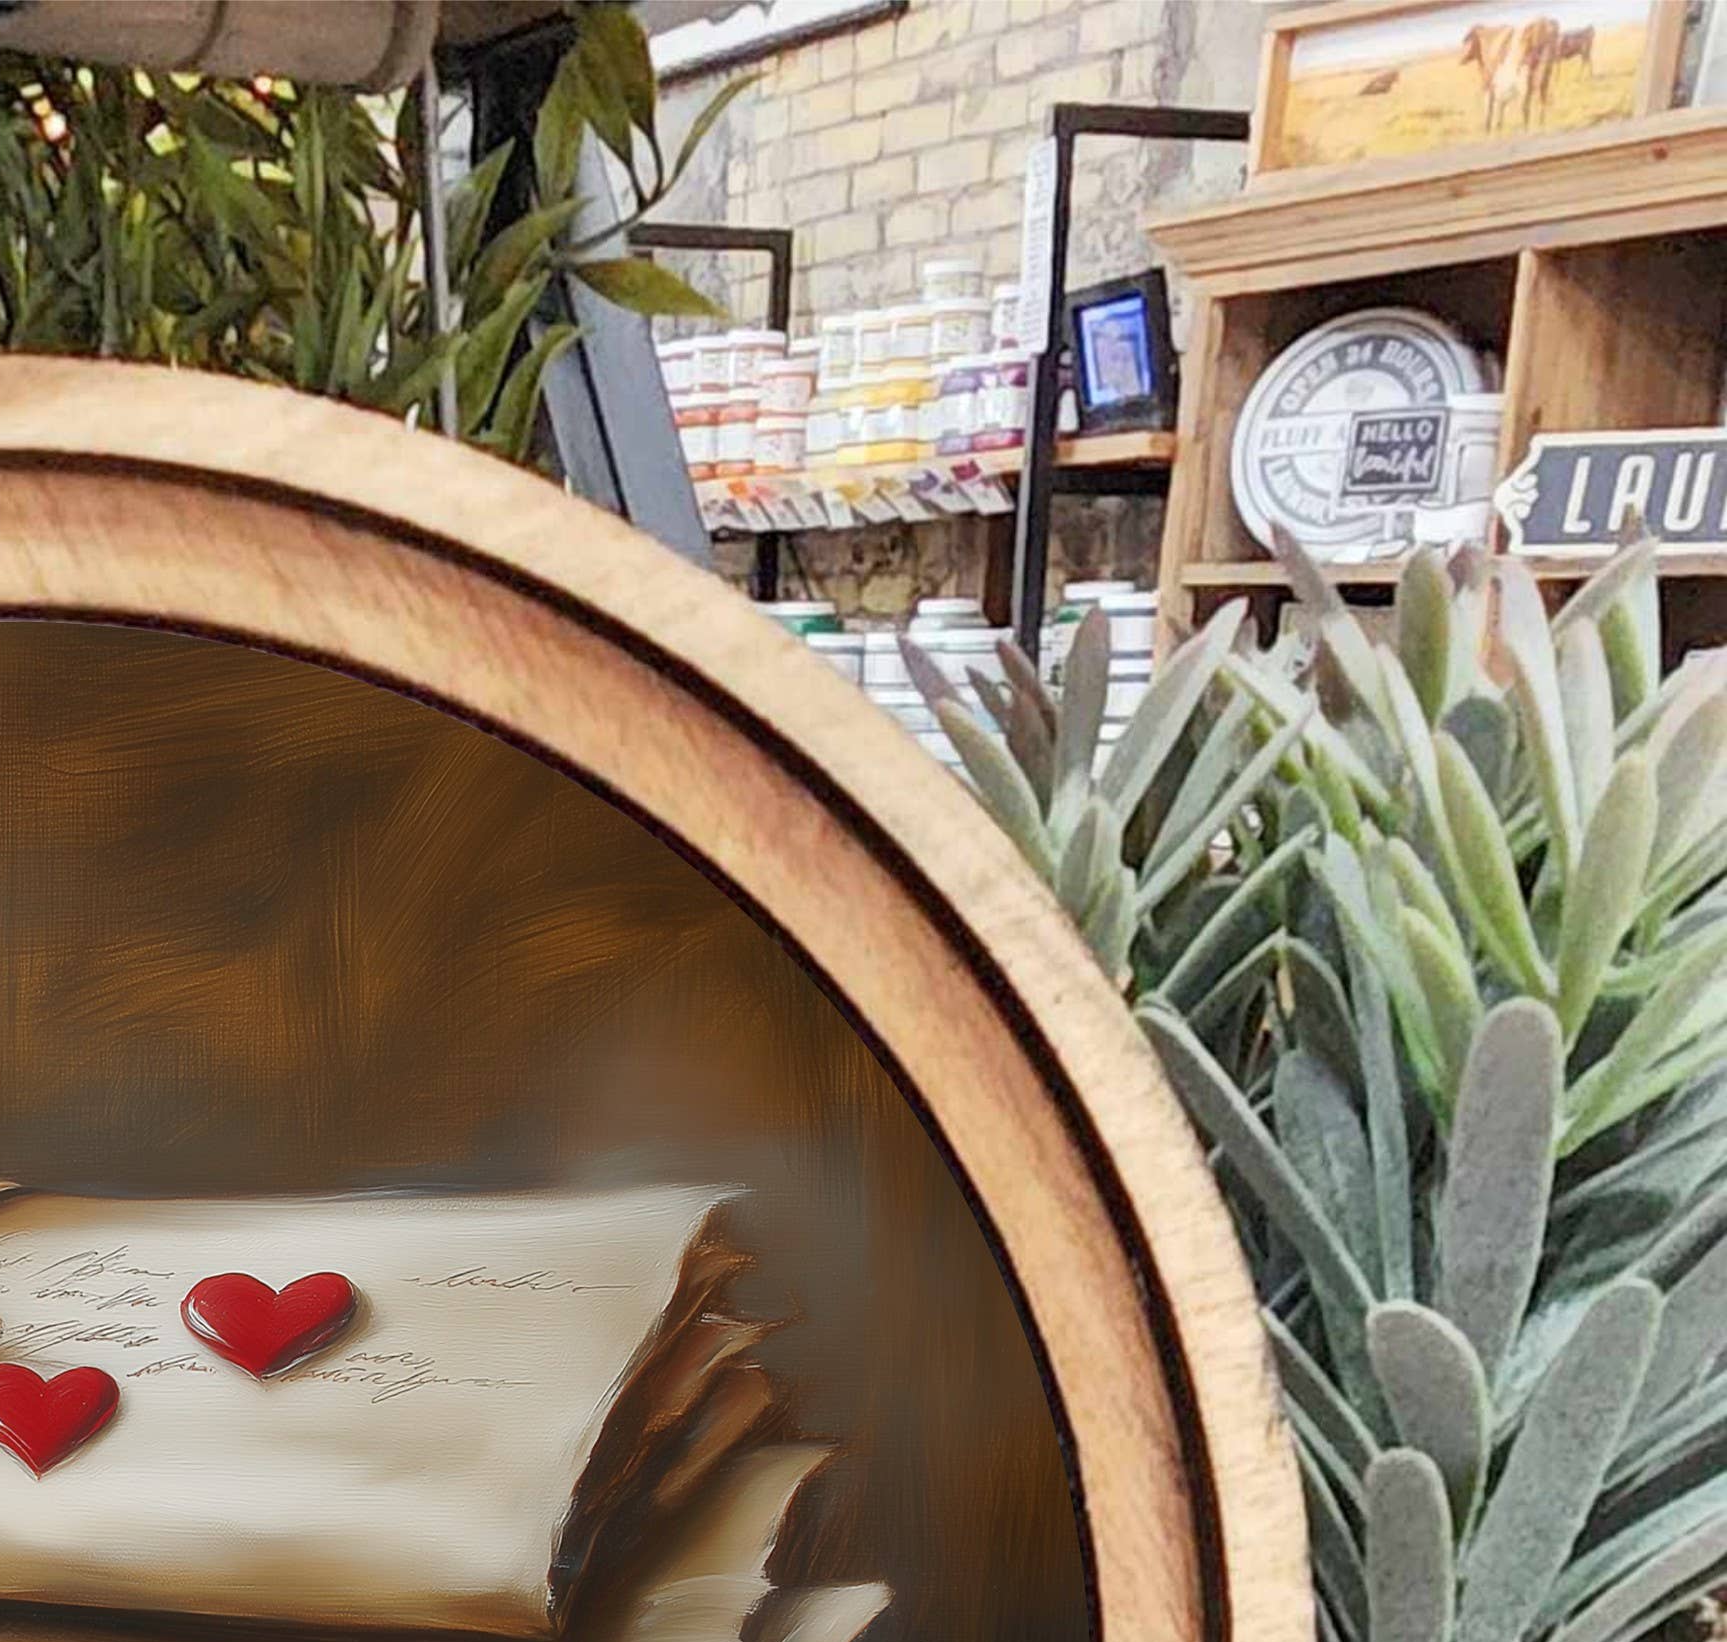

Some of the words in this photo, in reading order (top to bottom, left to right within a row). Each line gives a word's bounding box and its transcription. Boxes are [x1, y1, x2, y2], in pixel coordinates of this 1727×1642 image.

[1278, 350, 1339, 411] OPEN
[1378, 338, 1440, 403] HOURS
[1360, 418, 1433, 442] HELLO
[1562, 452, 1727, 534] LAU
